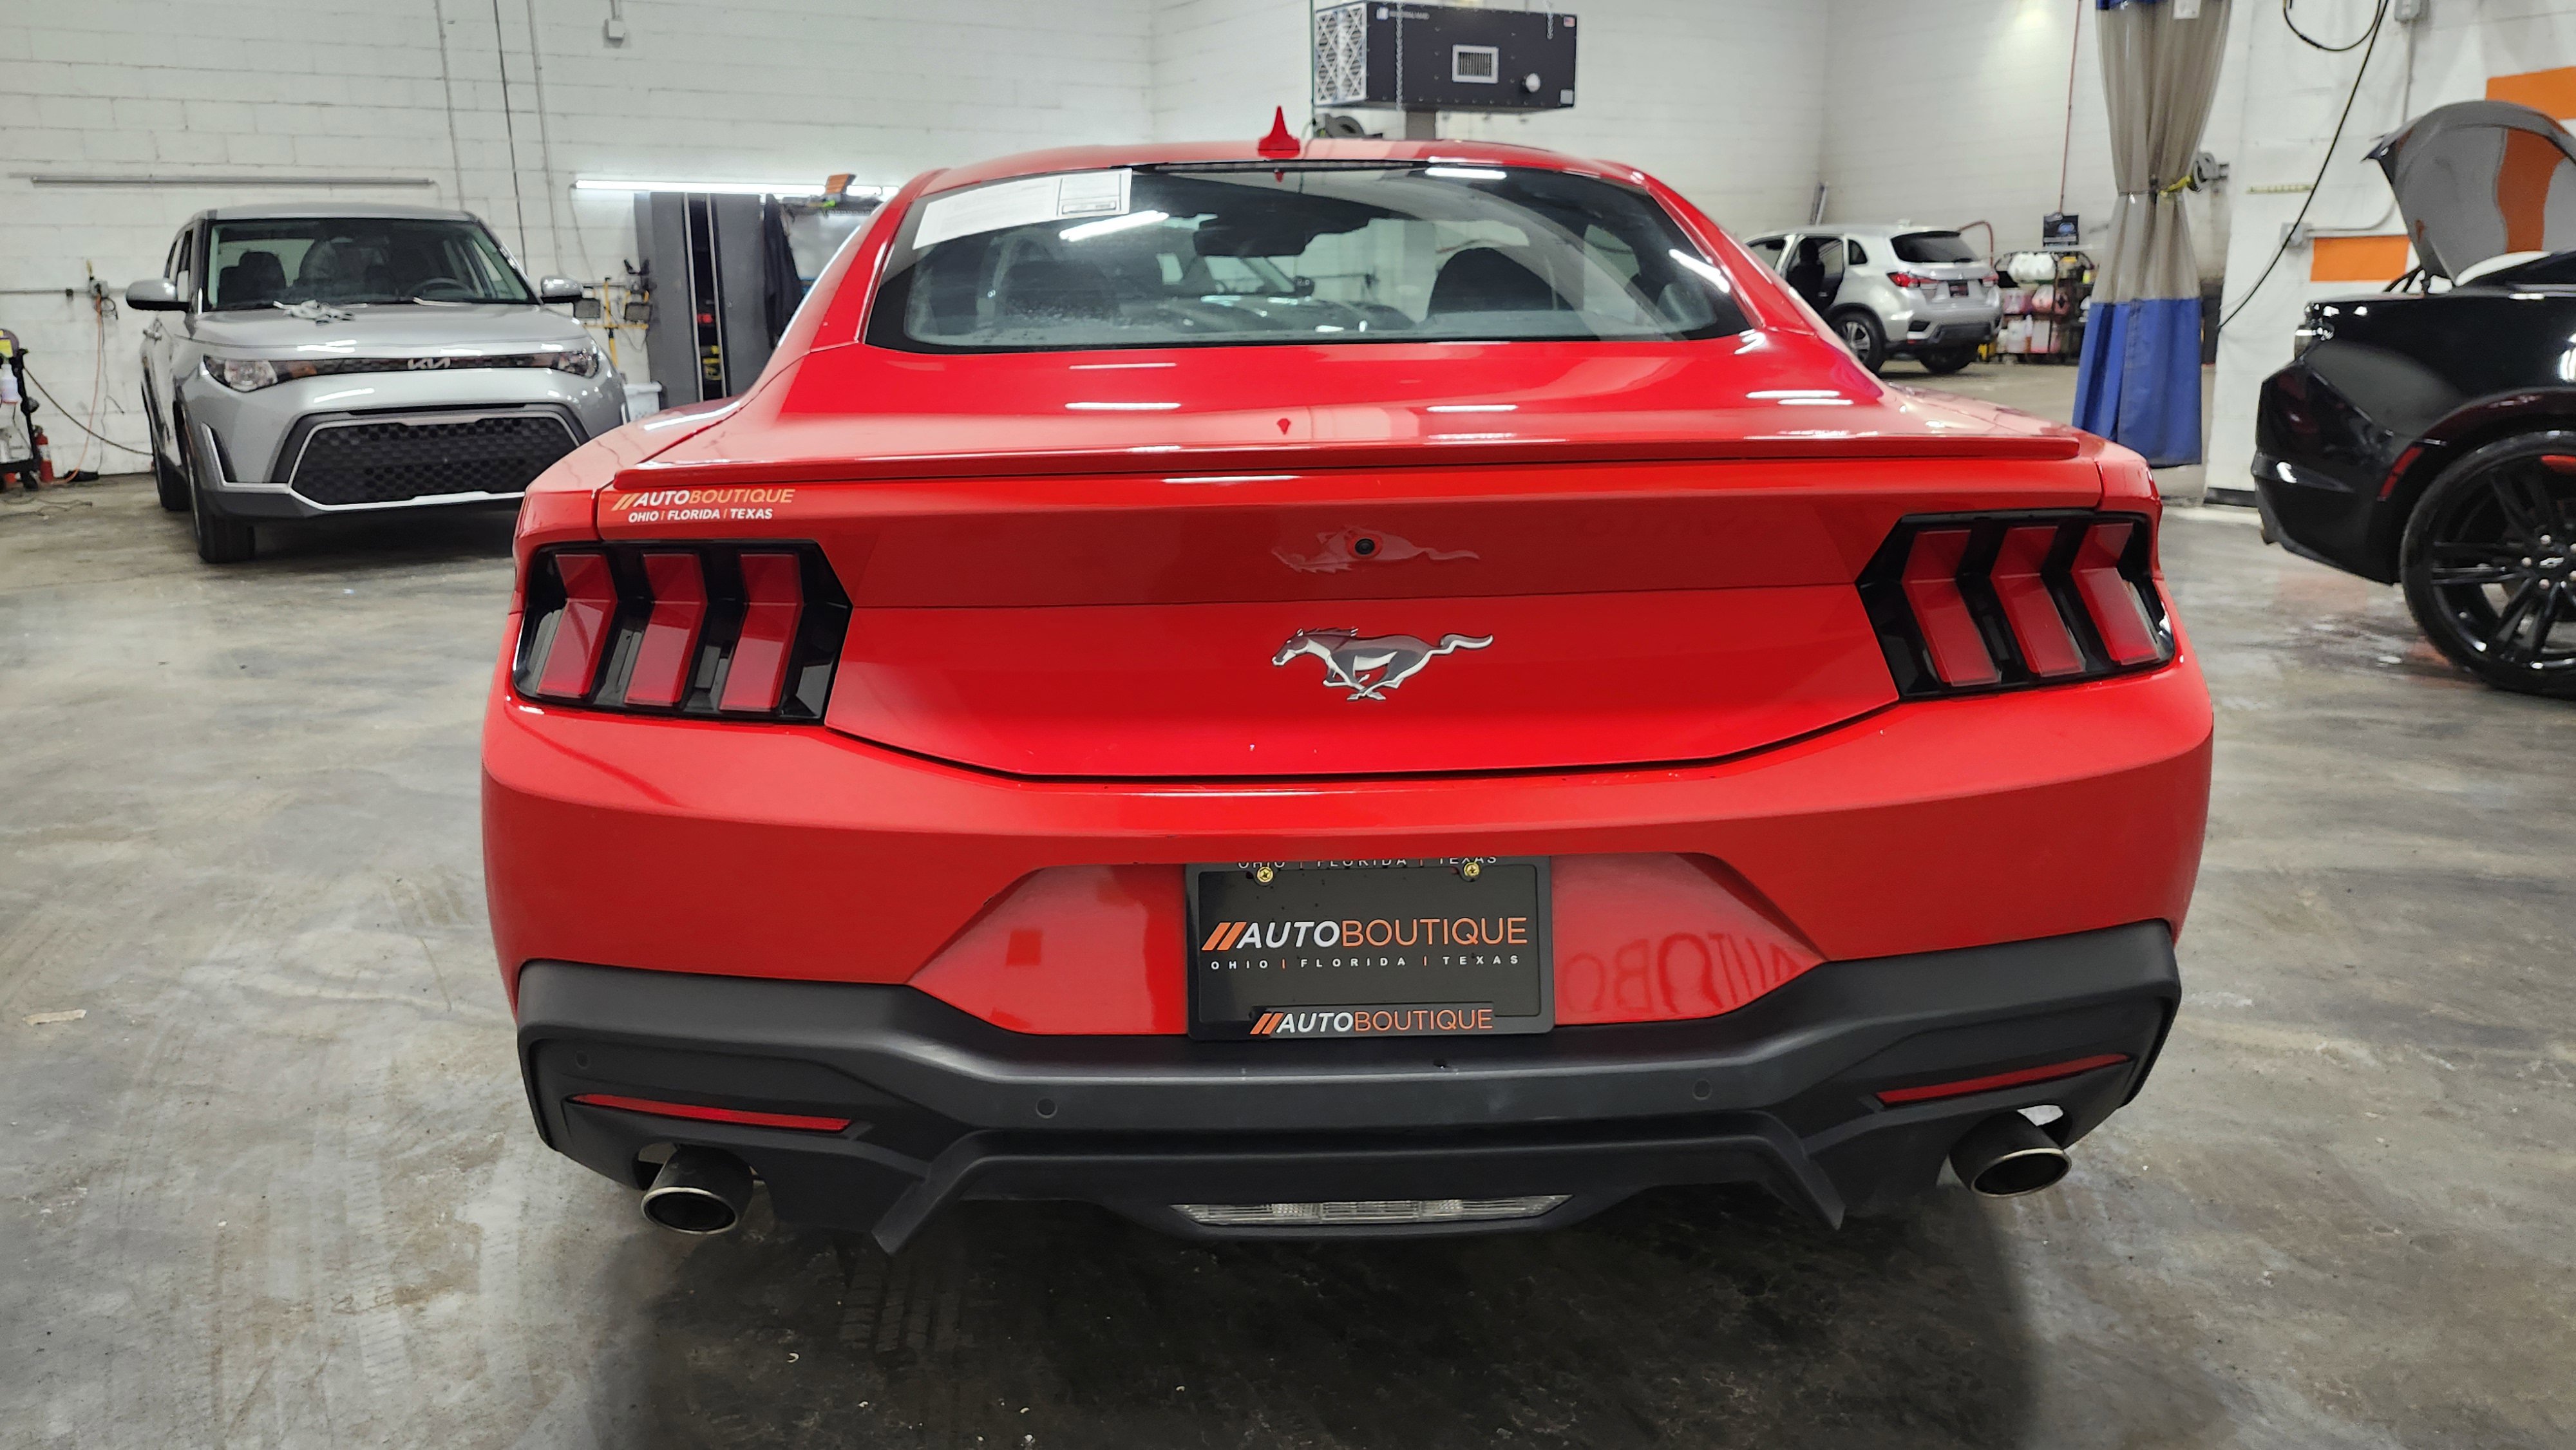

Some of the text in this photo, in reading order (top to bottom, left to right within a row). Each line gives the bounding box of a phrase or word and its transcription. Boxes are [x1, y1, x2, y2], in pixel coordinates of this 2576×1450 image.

[633, 489, 796, 507] AUTOBOUTIQUE
[628, 509, 659, 523] OHIO
[667, 509, 721, 521] FLORIDA
[730, 508, 773, 520] TEXAS
[1236, 917, 1528, 950] AUTOBOUTIQUE
[1210, 959, 1268, 970] OHIO
[1300, 957, 1406, 968] FLORIDA
[1443, 955, 1519, 965] TEXAS
[1276, 1008, 1493, 1034] AUTOBOUTIQUE
